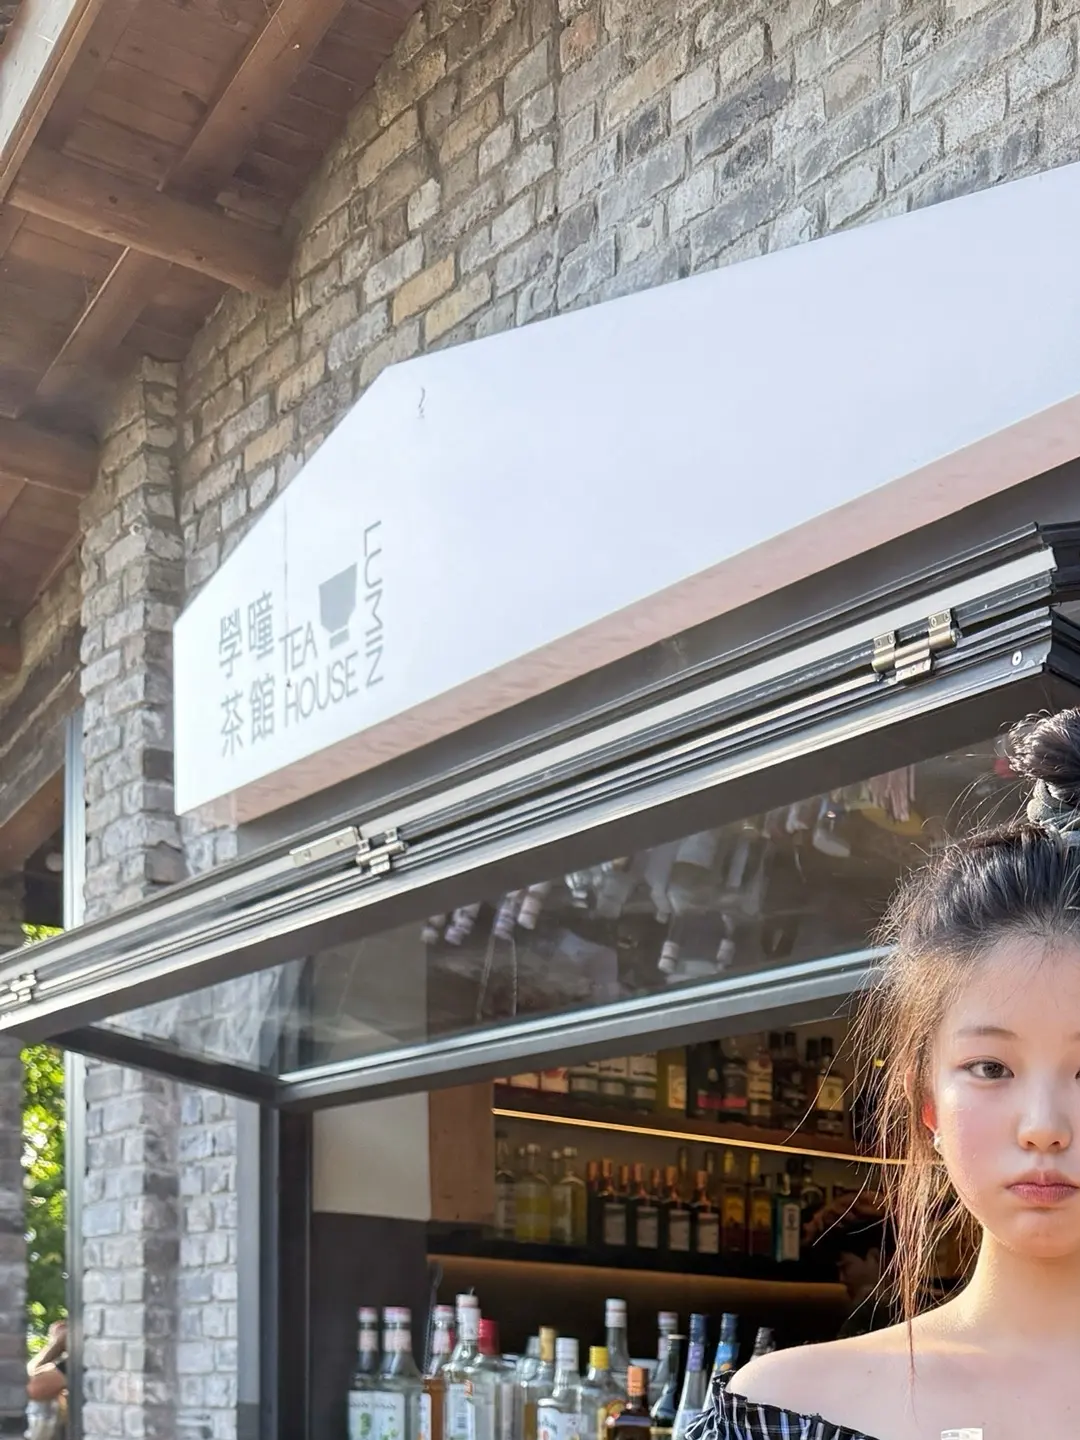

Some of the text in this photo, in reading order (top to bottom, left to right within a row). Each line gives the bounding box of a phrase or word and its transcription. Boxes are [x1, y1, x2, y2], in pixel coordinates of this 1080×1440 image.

[278, 621, 317, 675] TEA
[220, 673, 276, 757] 茶館
[284, 651, 359, 728] HOUSE
